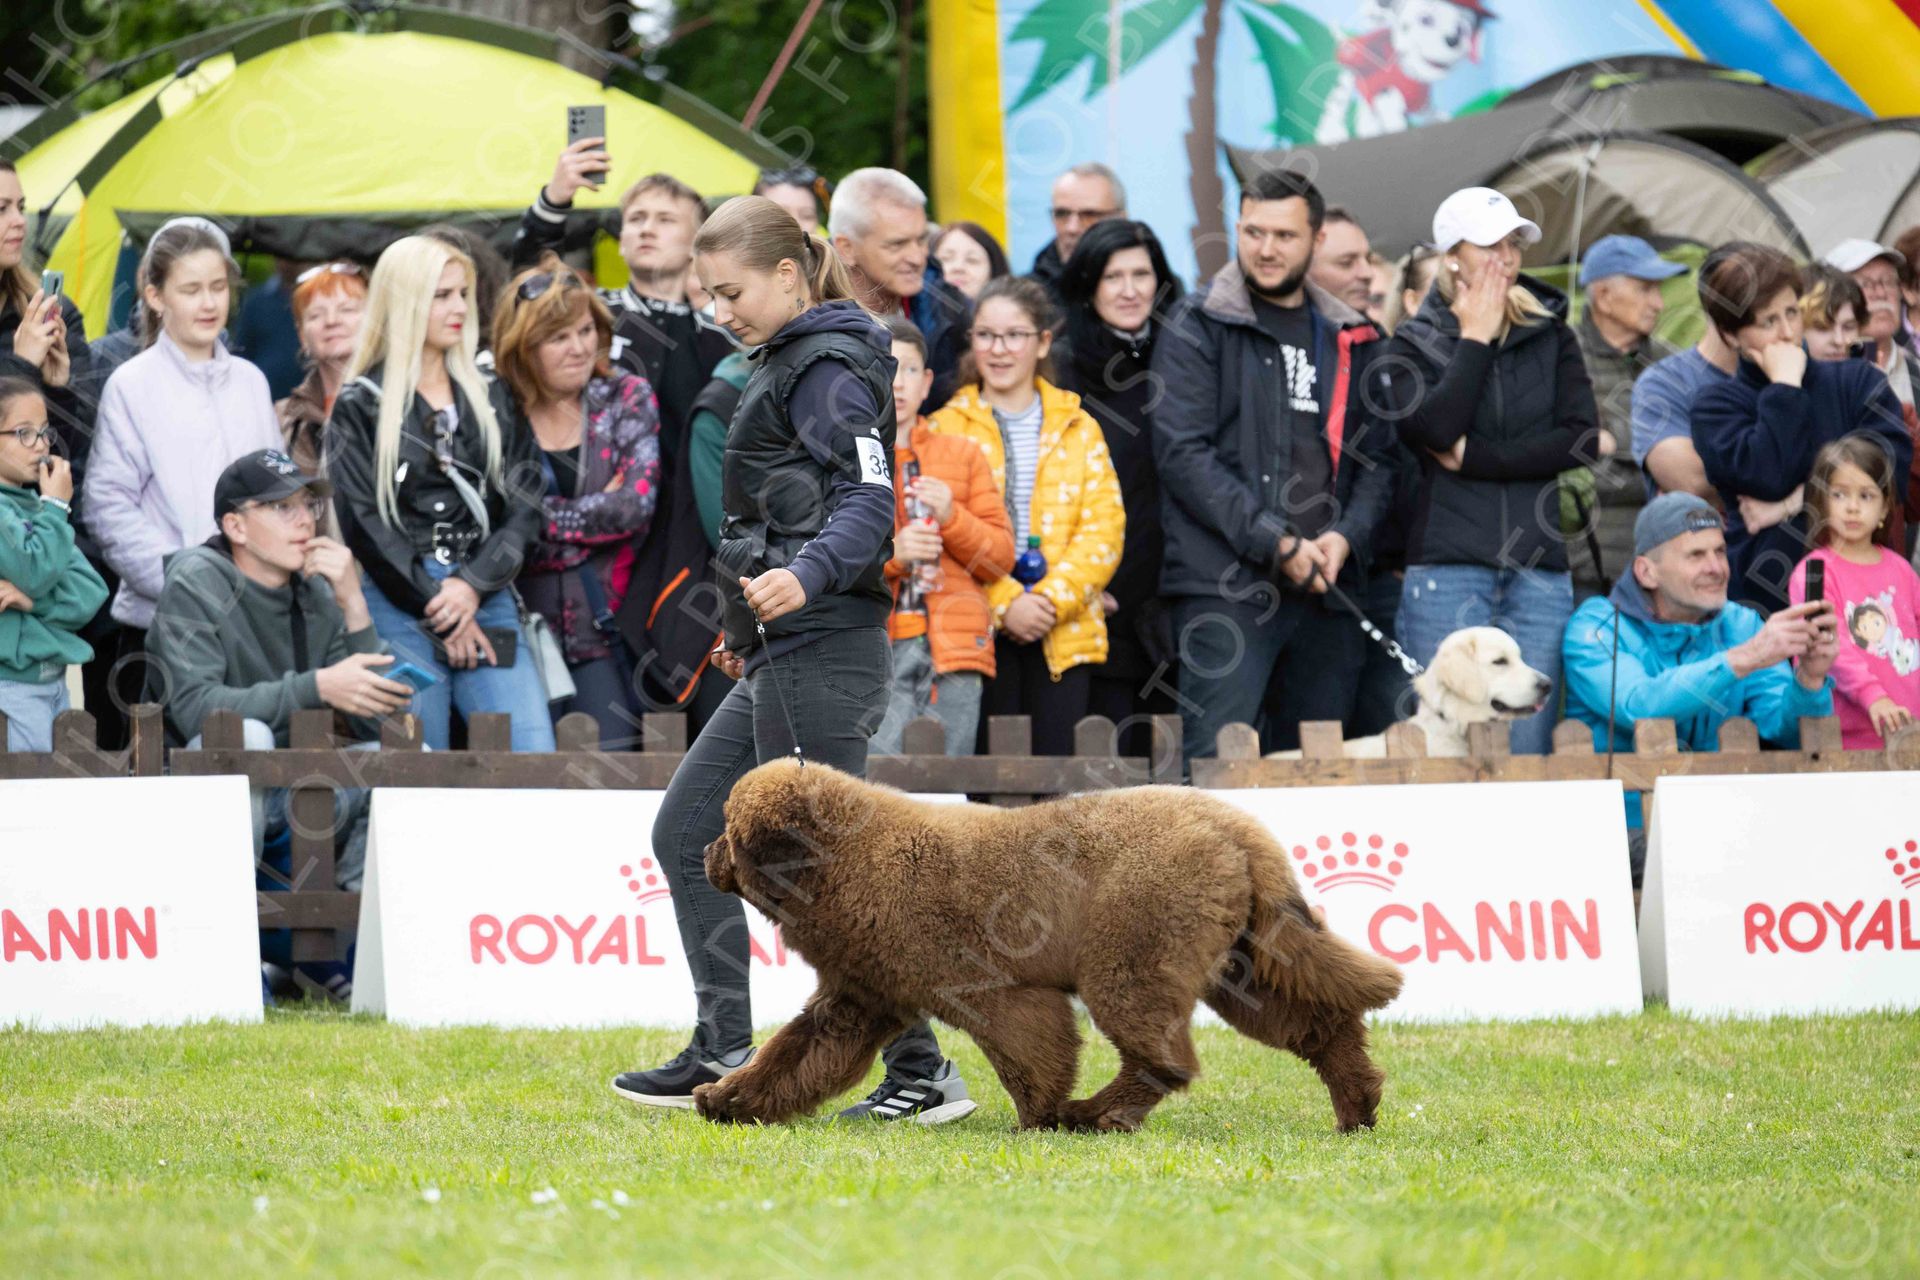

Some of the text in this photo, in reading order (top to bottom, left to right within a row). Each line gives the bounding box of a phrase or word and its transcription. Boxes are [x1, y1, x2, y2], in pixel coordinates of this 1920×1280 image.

[1, 907, 158, 962] ANIN
[469, 914, 666, 966] ROYAL
[1367, 898, 1602, 964] CANIN
[1743, 899, 1920, 954] ROYAL
